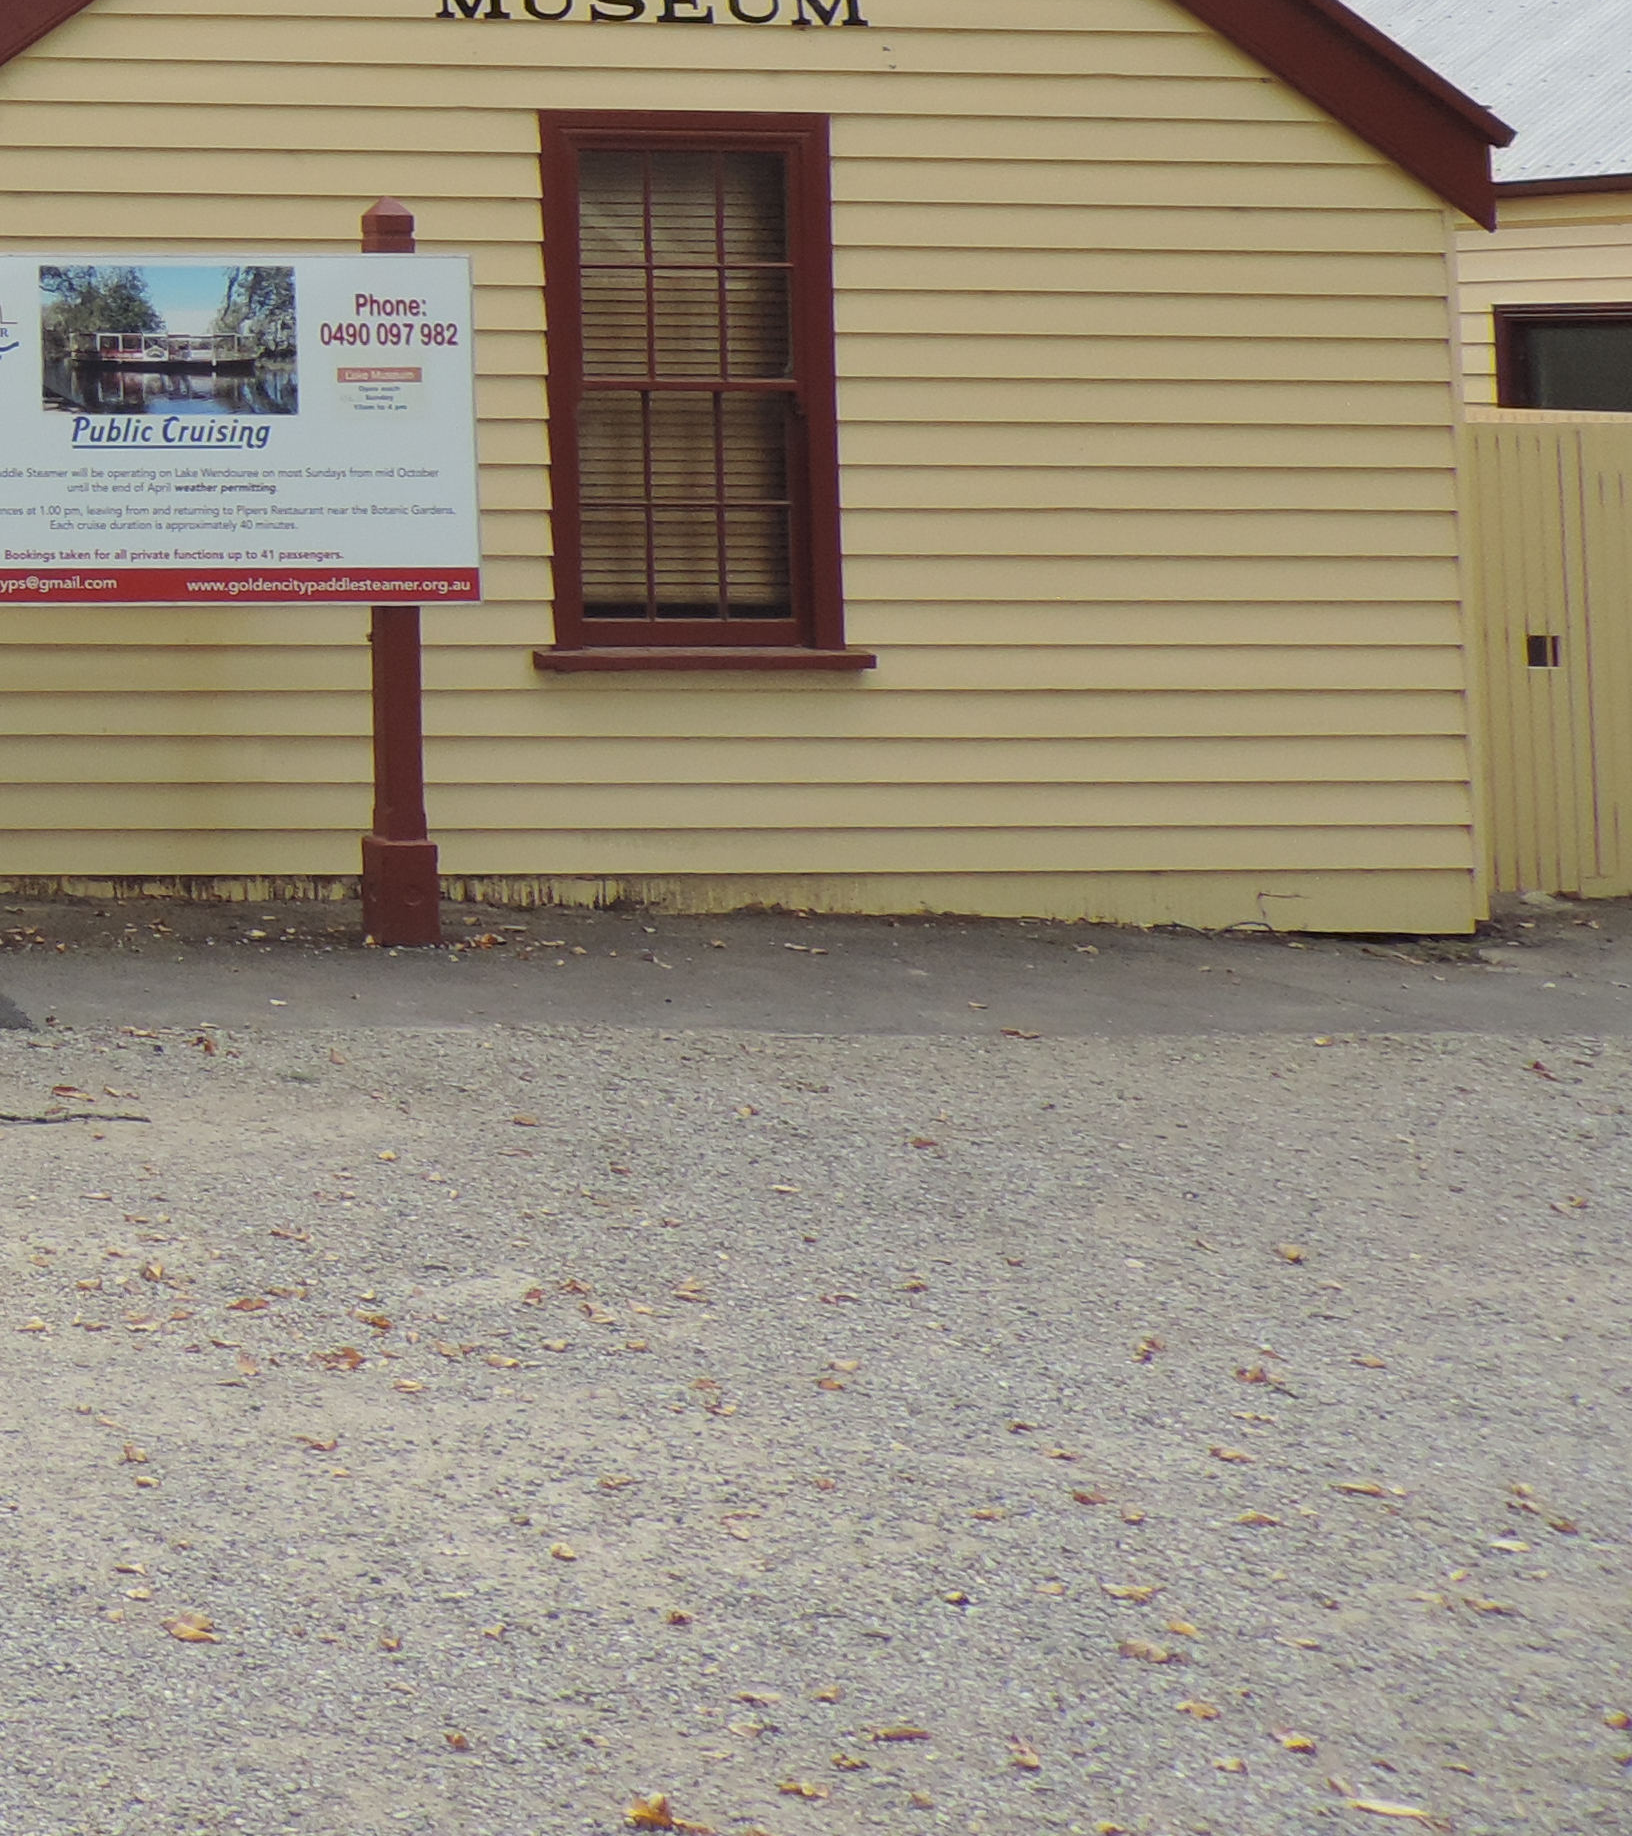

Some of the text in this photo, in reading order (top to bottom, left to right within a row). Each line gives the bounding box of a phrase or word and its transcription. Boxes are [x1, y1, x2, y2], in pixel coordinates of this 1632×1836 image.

[355, 293, 427, 317] Phone:
[320, 322, 459, 346] 0490 097 982
[71, 415, 271, 449] Public Cruising
[26, 468, 68, 478] Steamer
[71, 468, 88, 478] will
[91, 468, 104, 478] be
[107, 469, 156, 481] operating
[159, 470, 172, 478] on
[175, 468, 198, 478] Lake
[201, 468, 260, 479] Wendouree
[262, 469, 275, 478] on
[278, 468, 303, 478] most
[306, 468, 346, 480] Sundays
[349, 467, 373, 478] from
[375, 468, 395, 478] mid
[397, 468, 439, 479] October
[67, 482, 277, 495] until the end of April weather permitting.
[26, 506, 36, 516] at
[39, 506, 61, 516] 1.00
[64, 507, 84, 518] pm,
[86, 506, 122, 518] leaving
[125, 505, 150, 515] from
[153, 506, 171, 515] and
[174, 506, 219, 517] returning
[223, 506, 234, 515] to
[237, 505, 268, 518] Pipers
[271, 505, 324, 516] Restaurant
[327, 507, 349, 516] near
[351, 506, 368, 516] the
[371, 505, 409, 515] Botanic
[411, 505, 456, 516] Gardens.
[49, 520, 299, 532] Each cruise duration is approximately 40 minutes.
[4, 549, 344, 563] Bookings taken for all private functions up to 41 passengers.
[186, 577, 471, 596] www.goldencitypaddlesteamer.org.au
